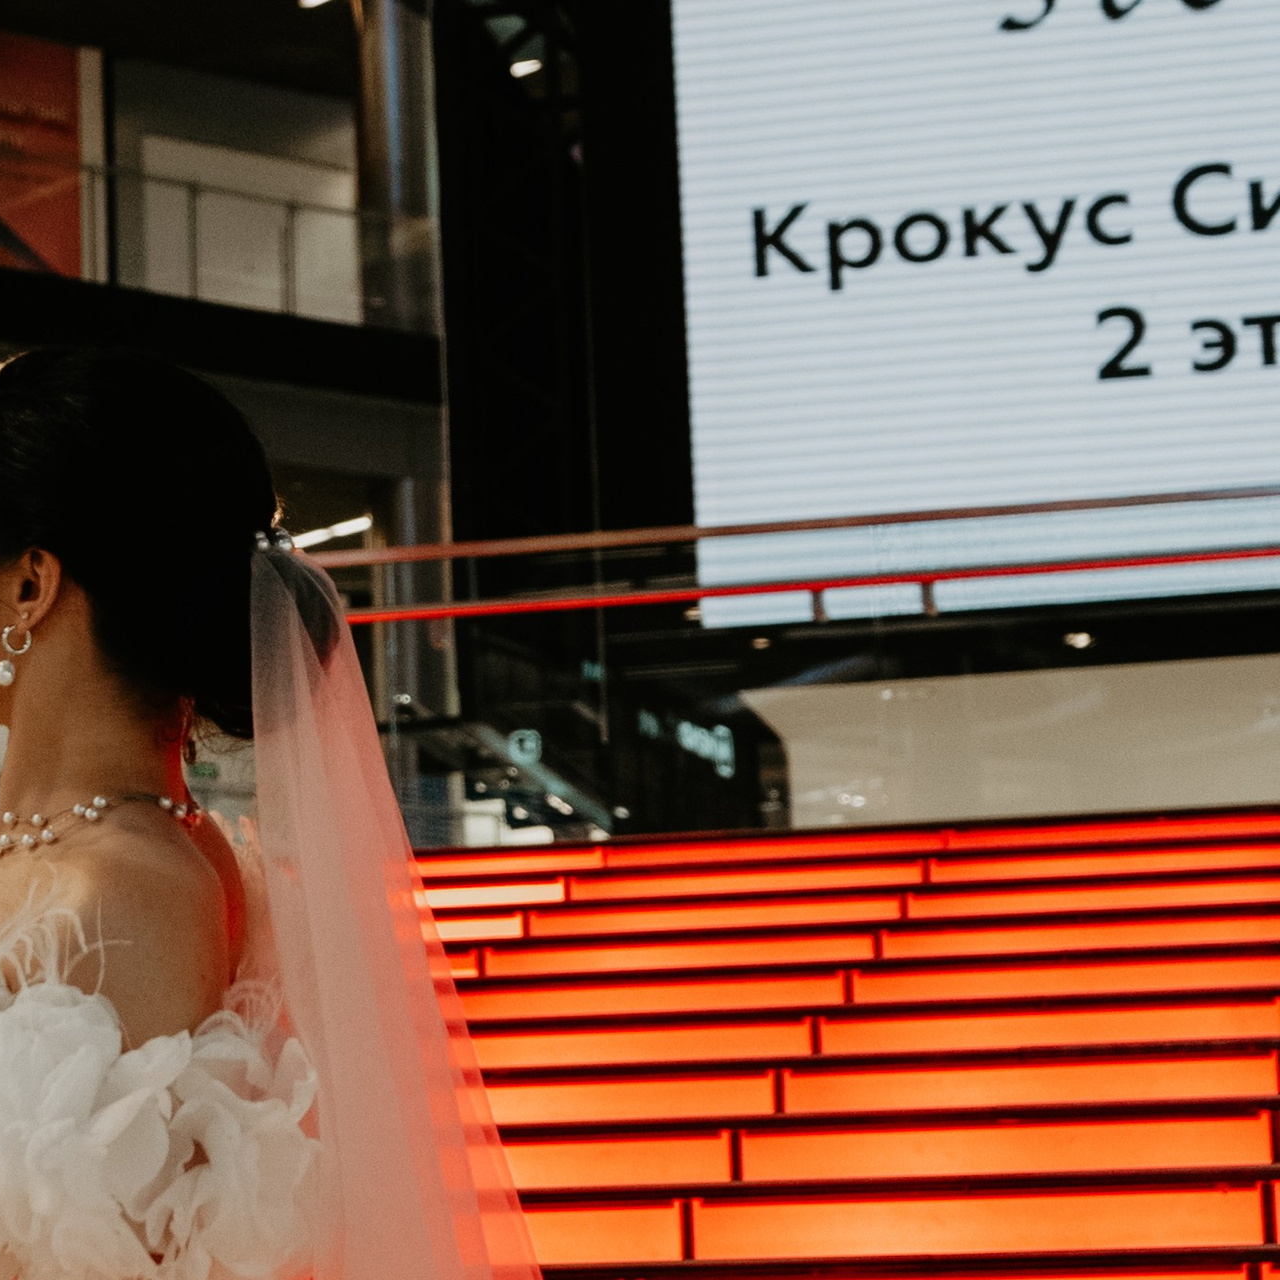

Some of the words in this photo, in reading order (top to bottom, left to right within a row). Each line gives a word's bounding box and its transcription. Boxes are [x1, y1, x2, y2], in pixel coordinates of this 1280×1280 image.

[751, 193, 1133, 291] Крокус
[1096, 306, 1152, 380] 2
[1190, 314, 1280, 373] эт
